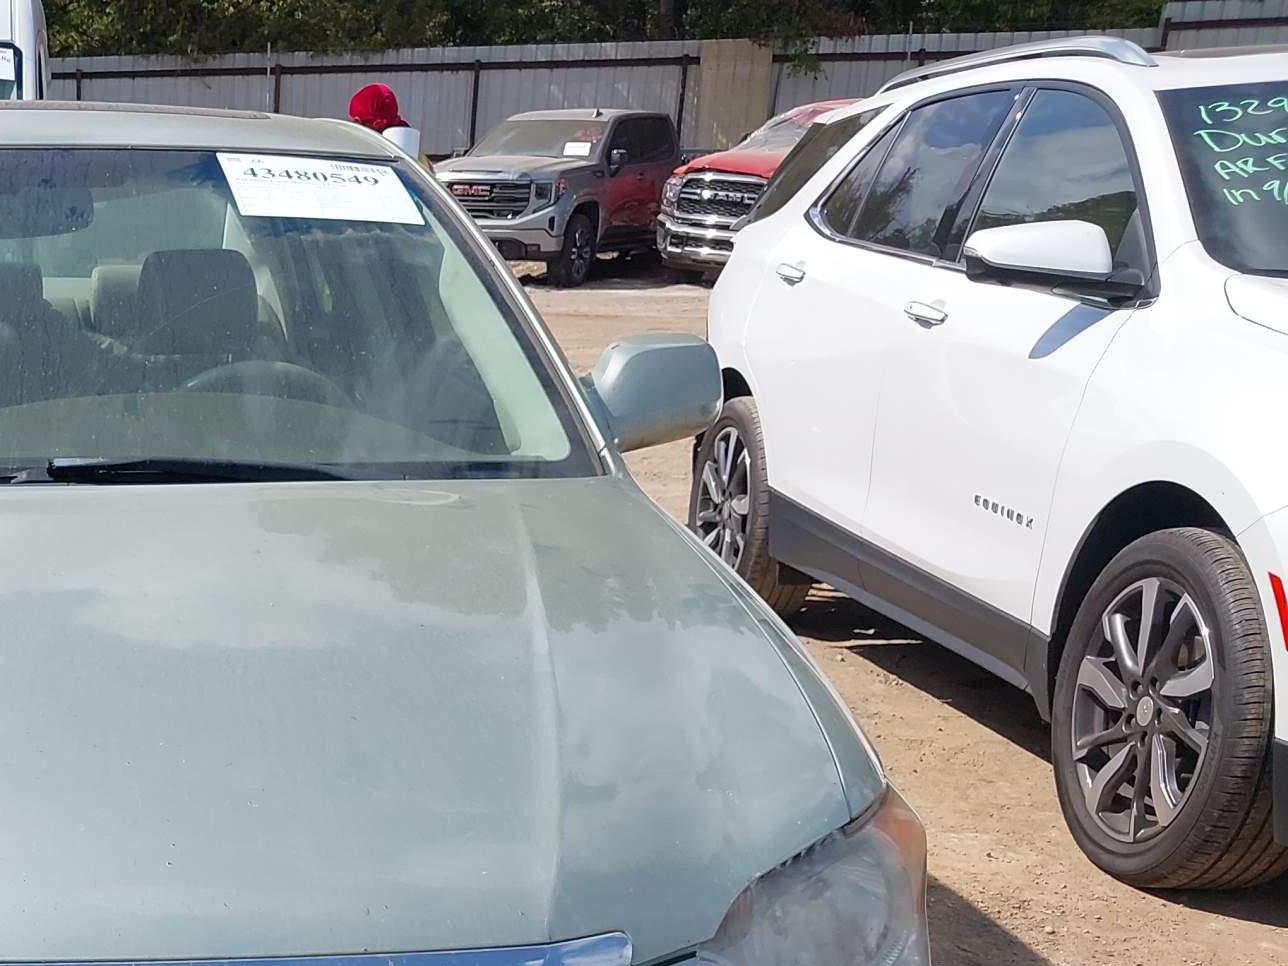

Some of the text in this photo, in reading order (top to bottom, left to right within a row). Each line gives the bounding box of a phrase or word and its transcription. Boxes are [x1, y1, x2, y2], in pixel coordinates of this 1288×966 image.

[243, 167, 380, 186] 43480549
[452, 184, 490, 197] GMC
[974, 494, 1034, 530] EQUINOX
